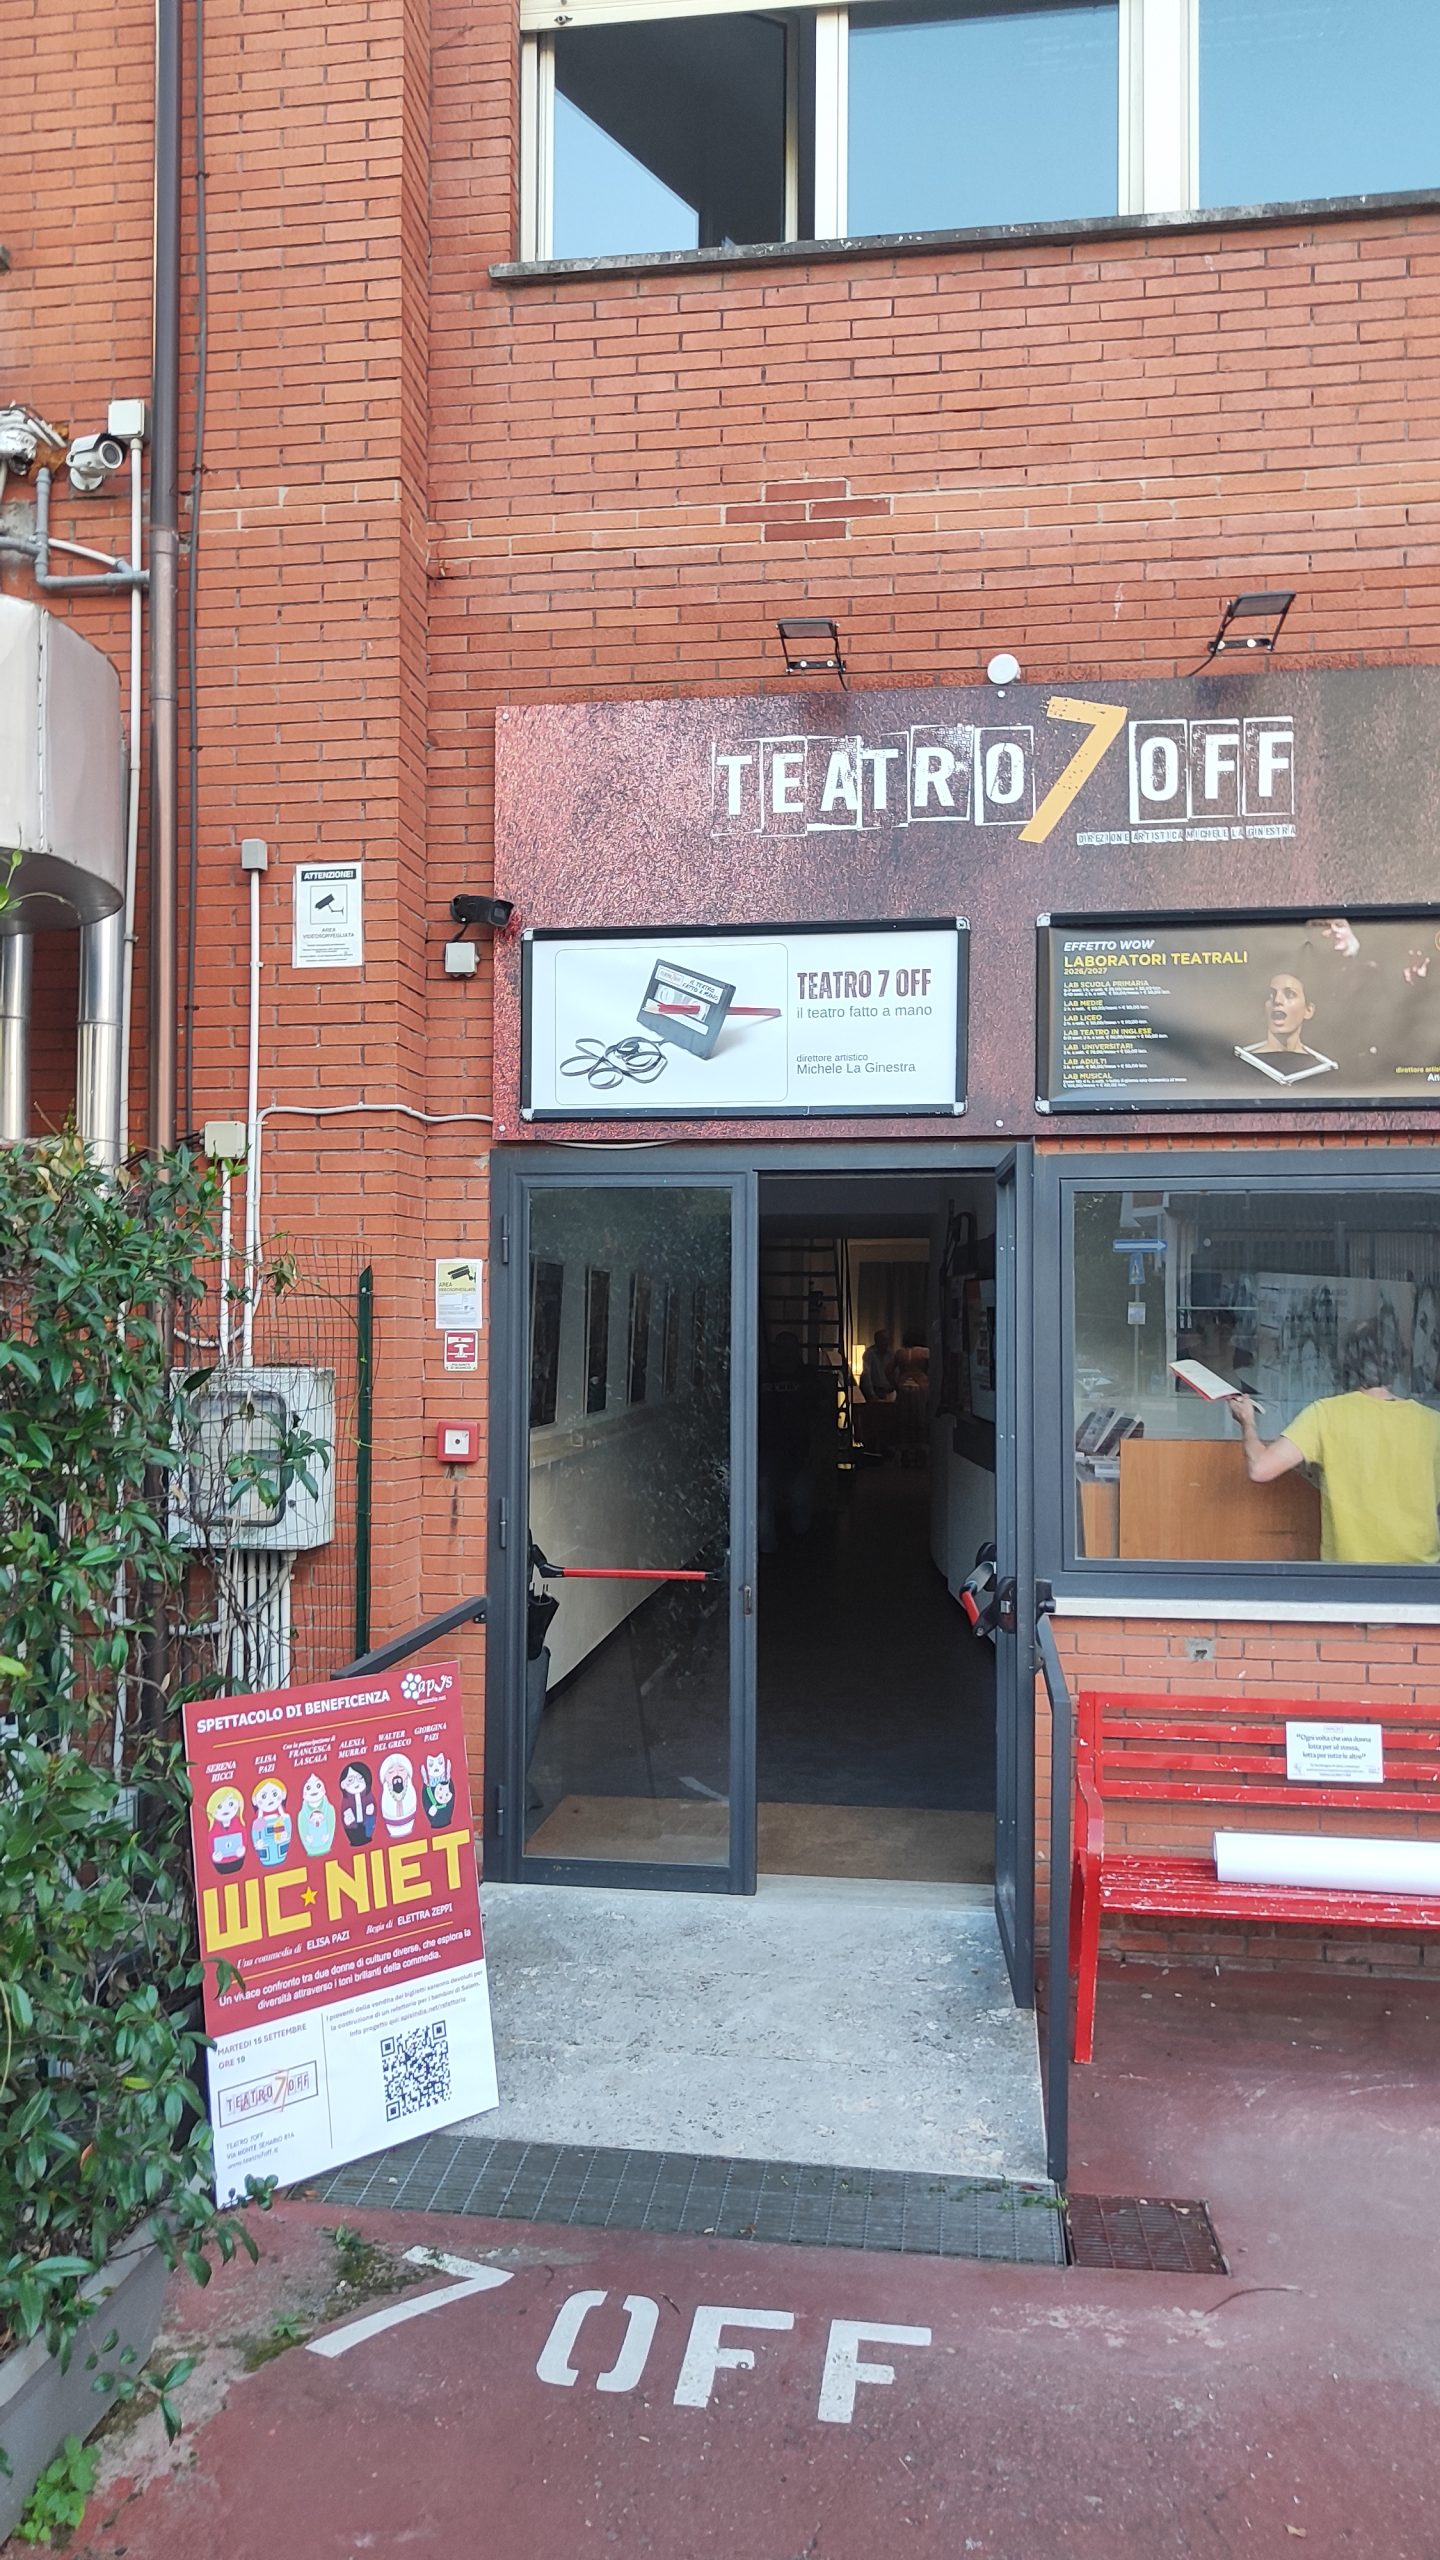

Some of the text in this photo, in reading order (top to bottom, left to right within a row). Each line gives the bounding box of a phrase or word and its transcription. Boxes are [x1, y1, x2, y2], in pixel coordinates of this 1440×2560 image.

[716, 695, 1294, 844] TEATRO 7 OFF
[1078, 825, 1296, 845] DIREZIONE ARTISTICA MICHELE LA GINESTRA
[1064, 939, 1155, 951] EFFETTO WOW
[1064, 951, 1248, 967] LABORATORI TEATRALI
[797, 968, 932, 1000] TEATRO 7 OFF
[796, 1005, 932, 1019] il teatro fatto a mano
[1081, 1042, 1133, 1050] UNIVERSITARI
[796, 1053, 869, 1063] direttore artistico
[796, 1061, 916, 1075] Michele La Ginestra
[197, 1690, 390, 1733] SPETTACOLO DI BENEFICENZA
[378, 1730, 406, 1741] WALTER
[414, 1722, 447, 1735] GIORGINA
[288, 1743, 331, 1758] FRANCESCA
[339, 1737, 365, 1749] ALEXIA
[373, 1738, 412, 1752] DEL GRECO
[254, 1753, 277, 1765] ELISA
[304, 1754, 328, 1765] SCALA
[338, 1746, 368, 1759] MURRAY
[205, 1760, 236, 1774] SERENA
[258, 1763, 275, 1774] PAZI
[211, 1770, 234, 1783] RICCI
[325, 1828, 470, 1921] NIET
[366, 1903, 453, 1935] Regia di ELETTRA ZEPPI
[236, 1930, 350, 1969] Una commedia di ELISA PAZI
[219, 1928, 472, 2007] Un confronto tra due donne di culture diverse, che esplora la
[257, 1950, 441, 2011] diversità attraverso toni brillanti della commedia.
[329, 1970, 483, 2023] proventi della vendita dei biglietti saranno devoluti per
[337, 2014, 374, 2030] costruzione
[374, 2011, 381, 2019] di
[417, 1997, 428, 2007] per
[431, 1989, 454, 2001] bambini
[253, 2037, 263, 2046] 15
[263, 2023, 307, 2043] SETTEMBRE
[349, 2021, 388, 2038] Info progetto
[218, 2055, 246, 2070] ORE 19
[226, 2073, 309, 2113] TEATRO 7 OFF
[226, 2136, 249, 2150] TEATRO
[226, 2152, 237, 2160] VIA
[237, 2146, 257, 2157] MONTE
[258, 2136, 283, 2149] SENARIO
[304, 2245, 932, 2424] 7 OFF
